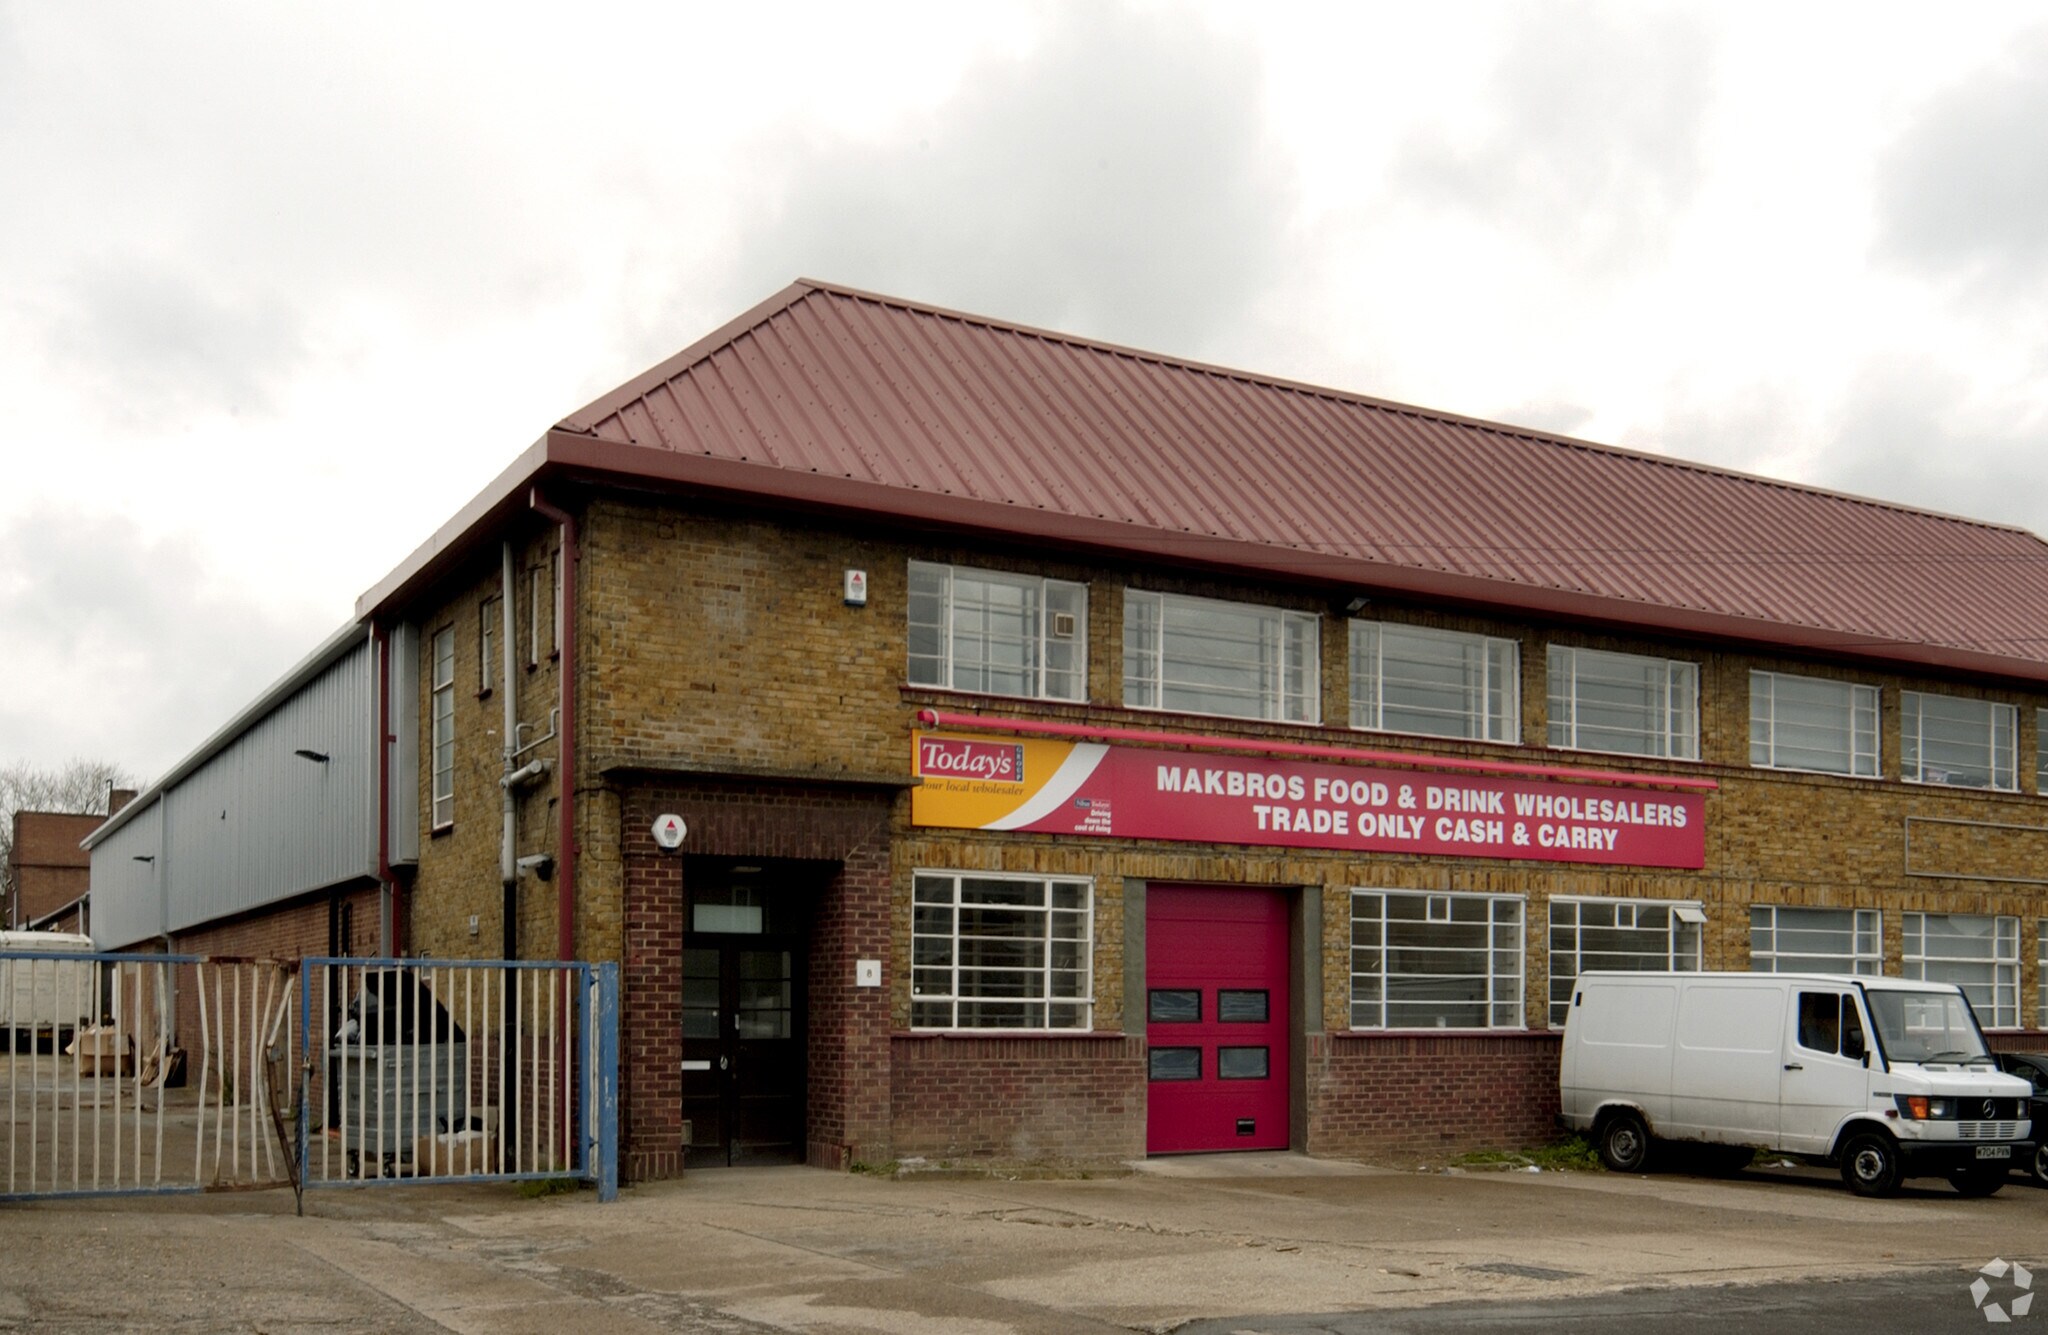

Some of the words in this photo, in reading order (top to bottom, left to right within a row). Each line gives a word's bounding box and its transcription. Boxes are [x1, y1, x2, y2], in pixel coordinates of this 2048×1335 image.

[922, 742, 1012, 779] Today's
[1015, 745, 1023, 781] GROUP
[946, 781, 970, 792] local
[973, 783, 1025, 795] wholesaler
[1157, 765, 1305, 801] MAKBROS
[1314, 778, 1389, 806] FOOD
[1397, 785, 1417, 809] &
[1426, 786, 1505, 815] DRINK
[1514, 793, 1687, 828] WHOLESALERS
[1253, 805, 1349, 835] TRADE
[1357, 812, 1426, 840] ONLY
[1435, 817, 1504, 844] CASH
[1512, 822, 1530, 846] &
[1537, 823, 1618, 851] CARRY
